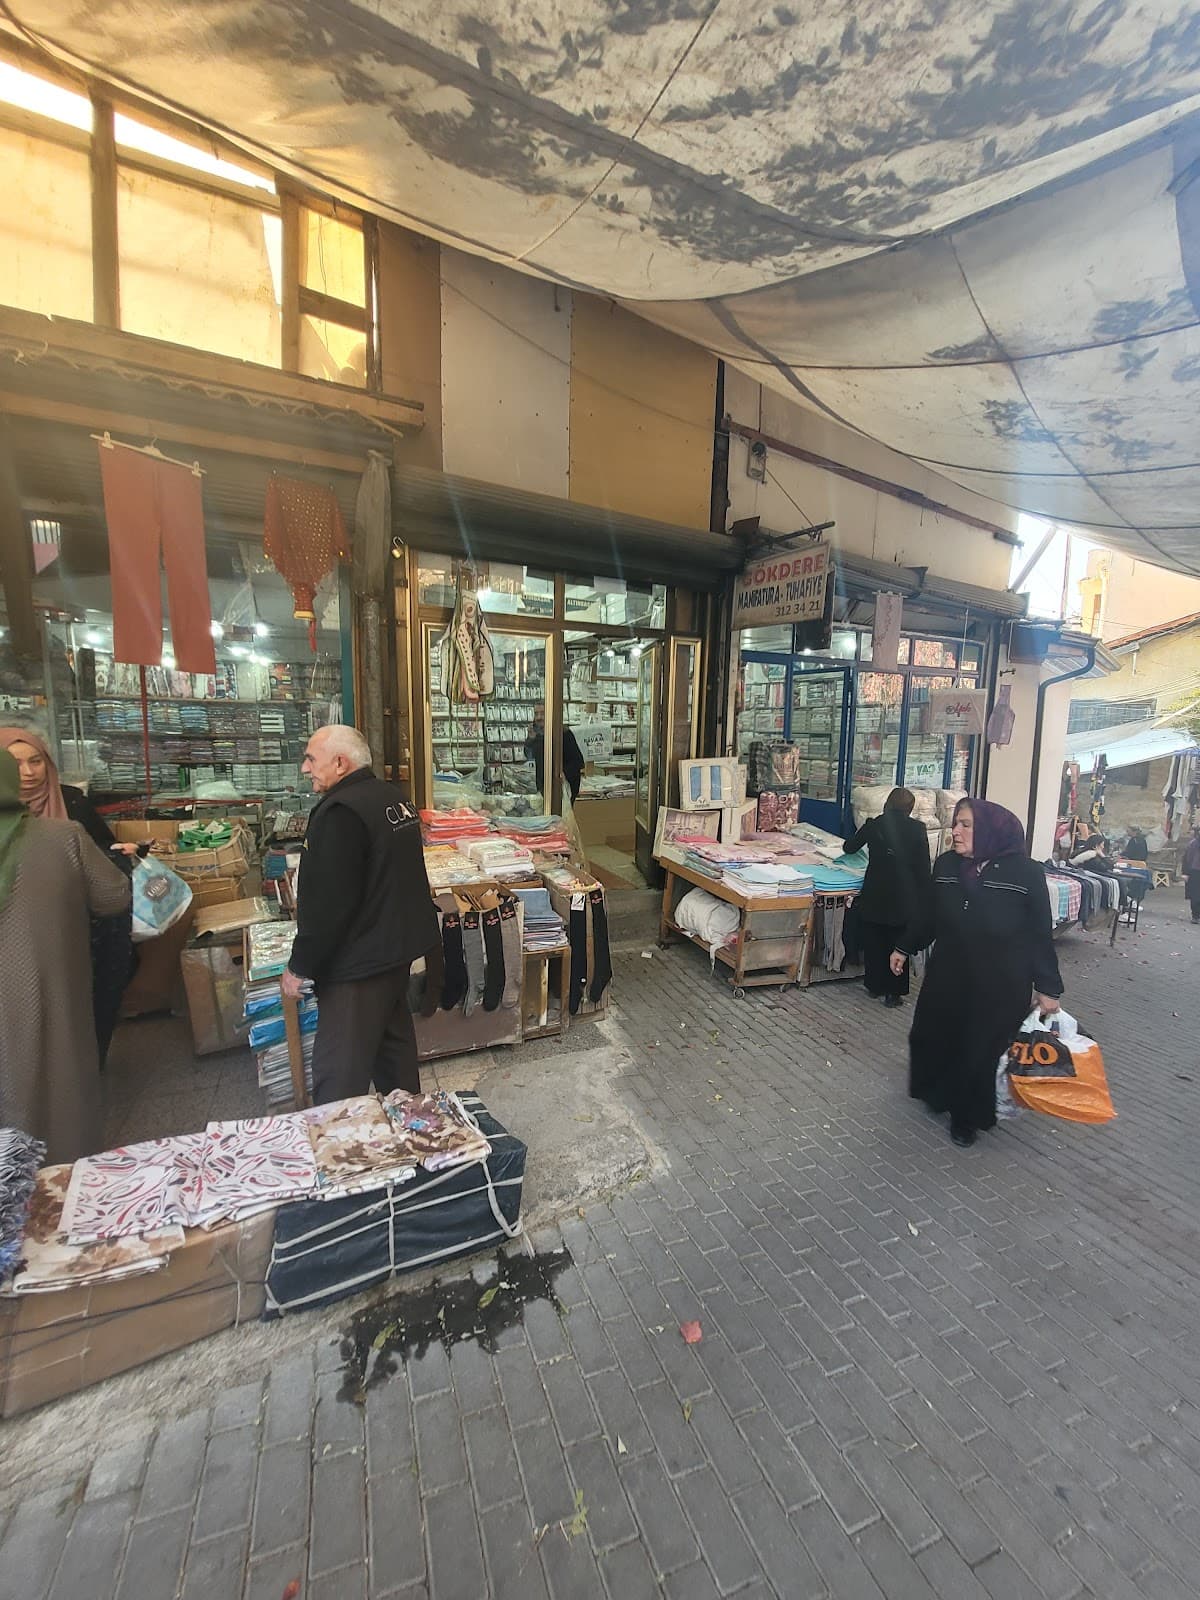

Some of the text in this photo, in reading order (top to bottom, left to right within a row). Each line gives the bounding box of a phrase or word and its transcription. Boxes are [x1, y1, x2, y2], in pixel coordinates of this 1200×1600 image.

[775, 600, 820, 617] 312 34 21
